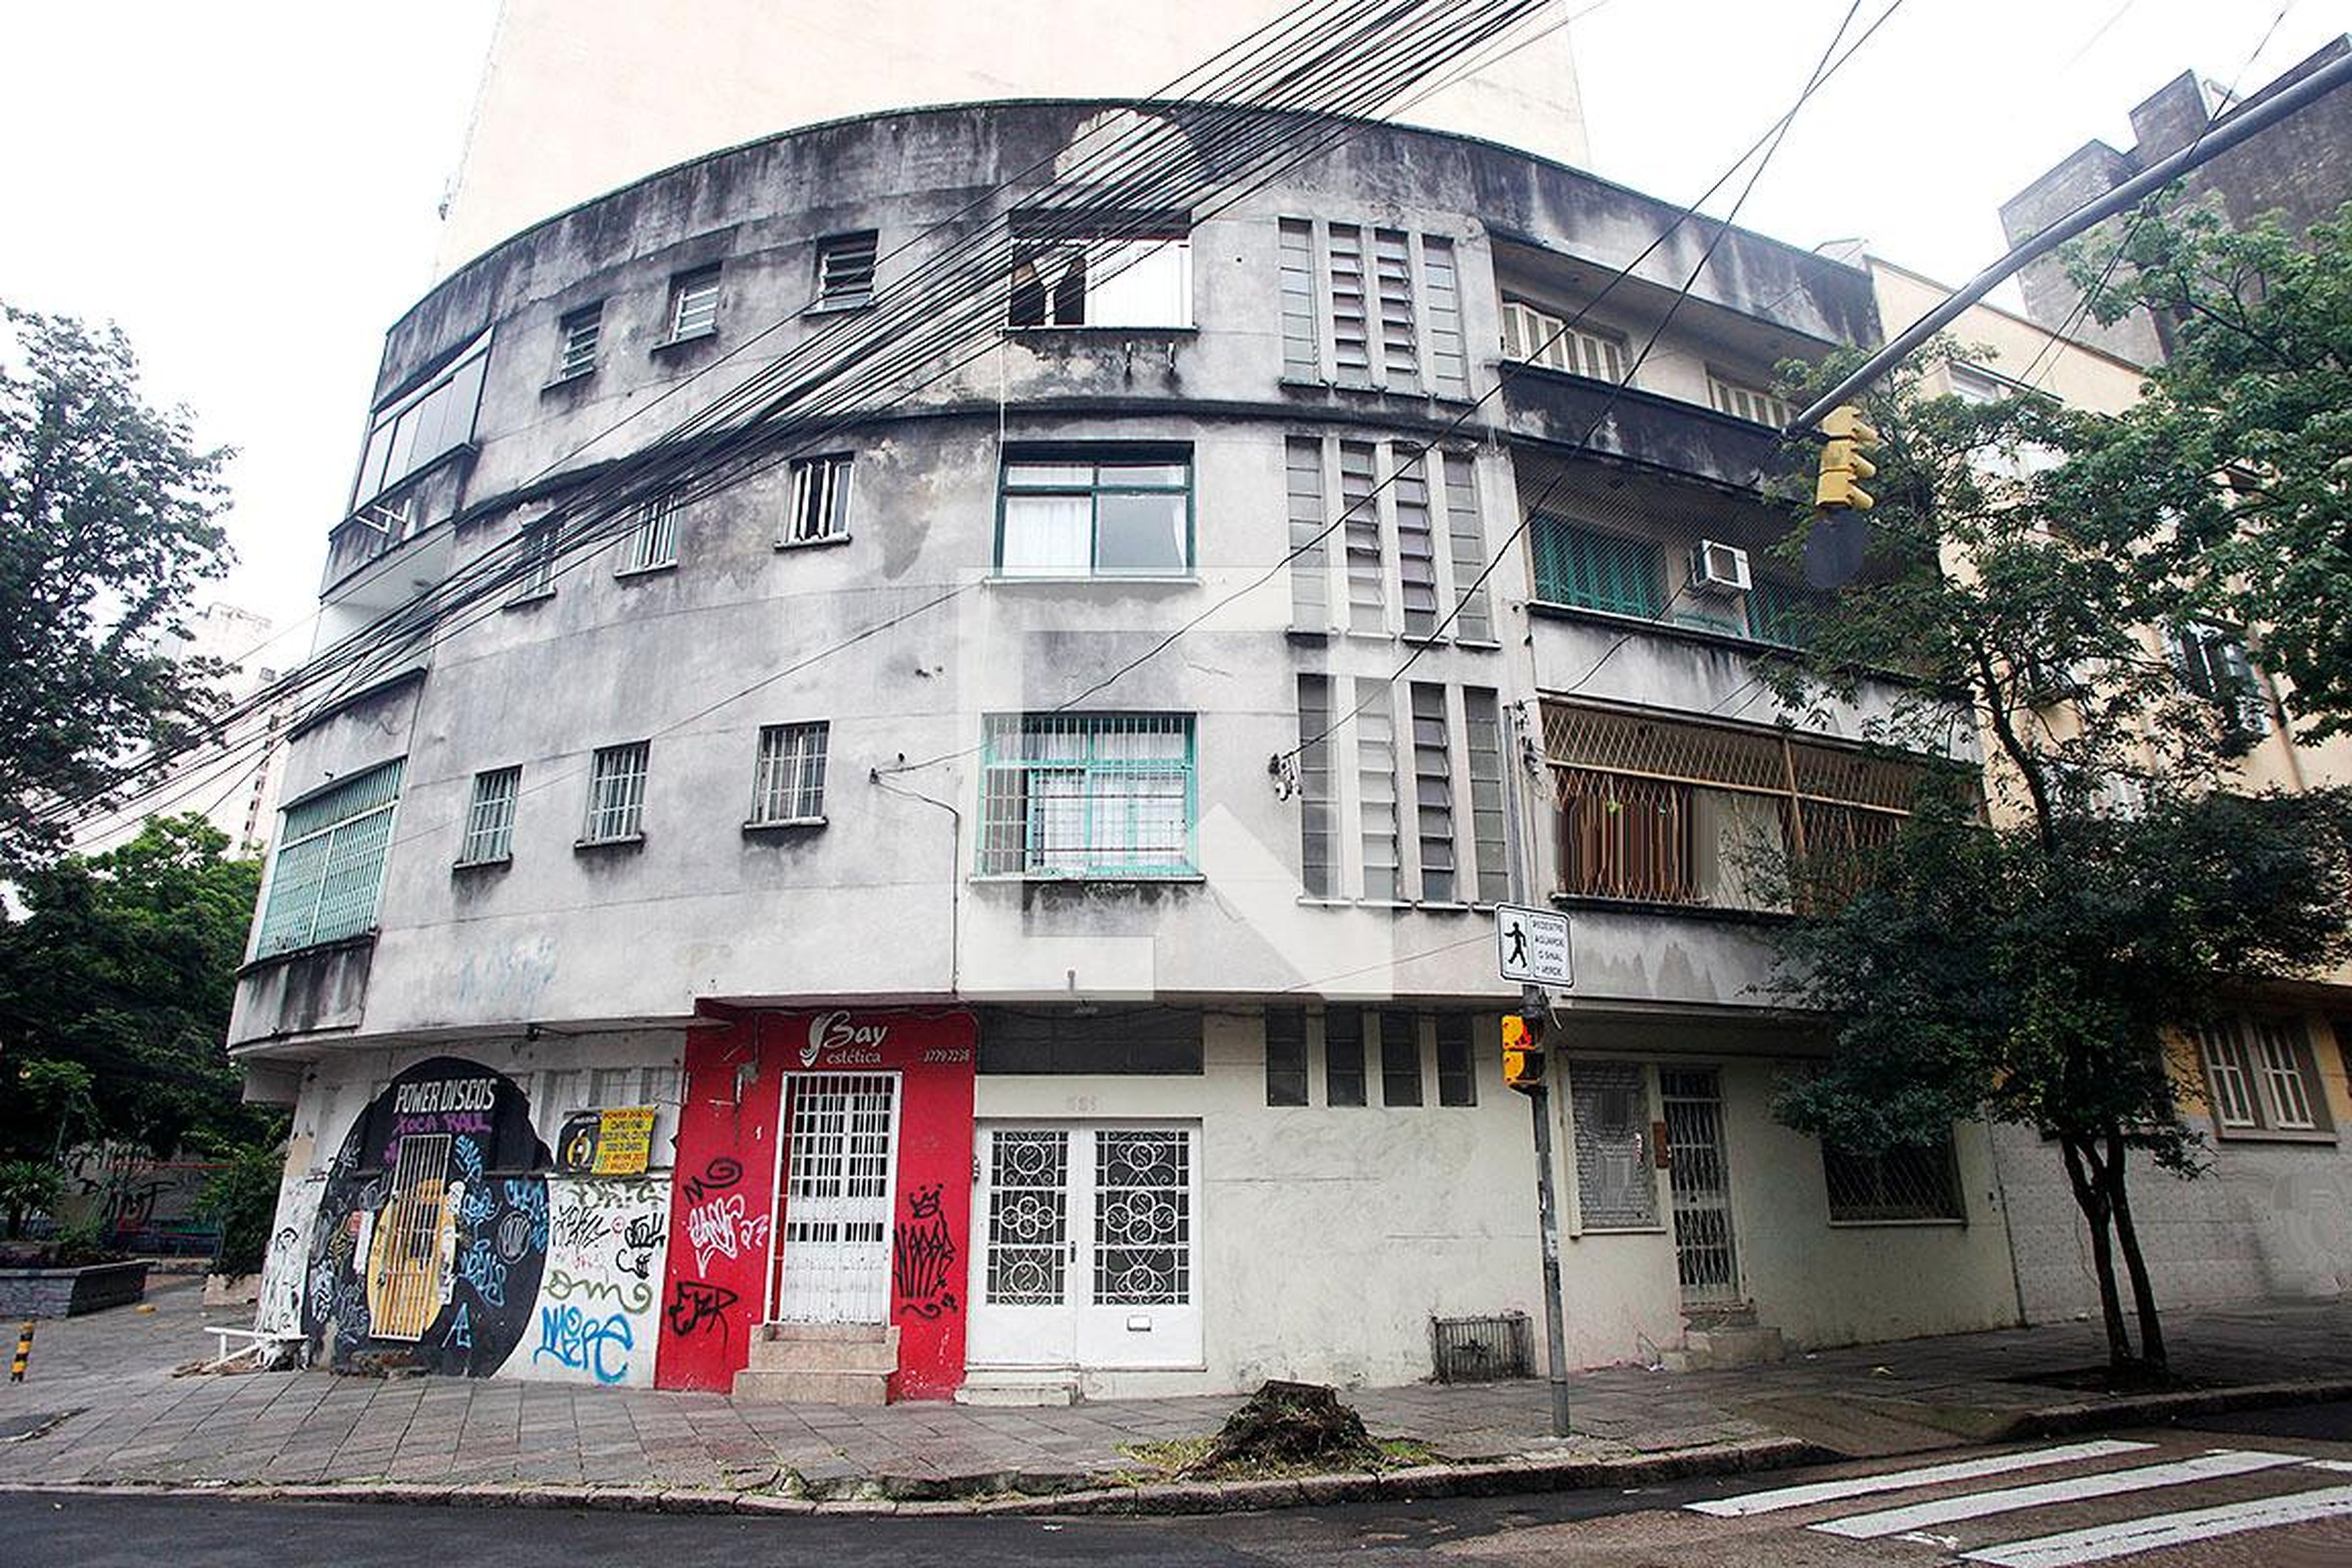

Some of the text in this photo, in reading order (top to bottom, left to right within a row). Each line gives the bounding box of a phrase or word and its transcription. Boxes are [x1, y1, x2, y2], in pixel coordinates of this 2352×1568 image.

[826, 1048, 881, 1064] estética
[394, 1077, 497, 1114] POWER DISCOS
